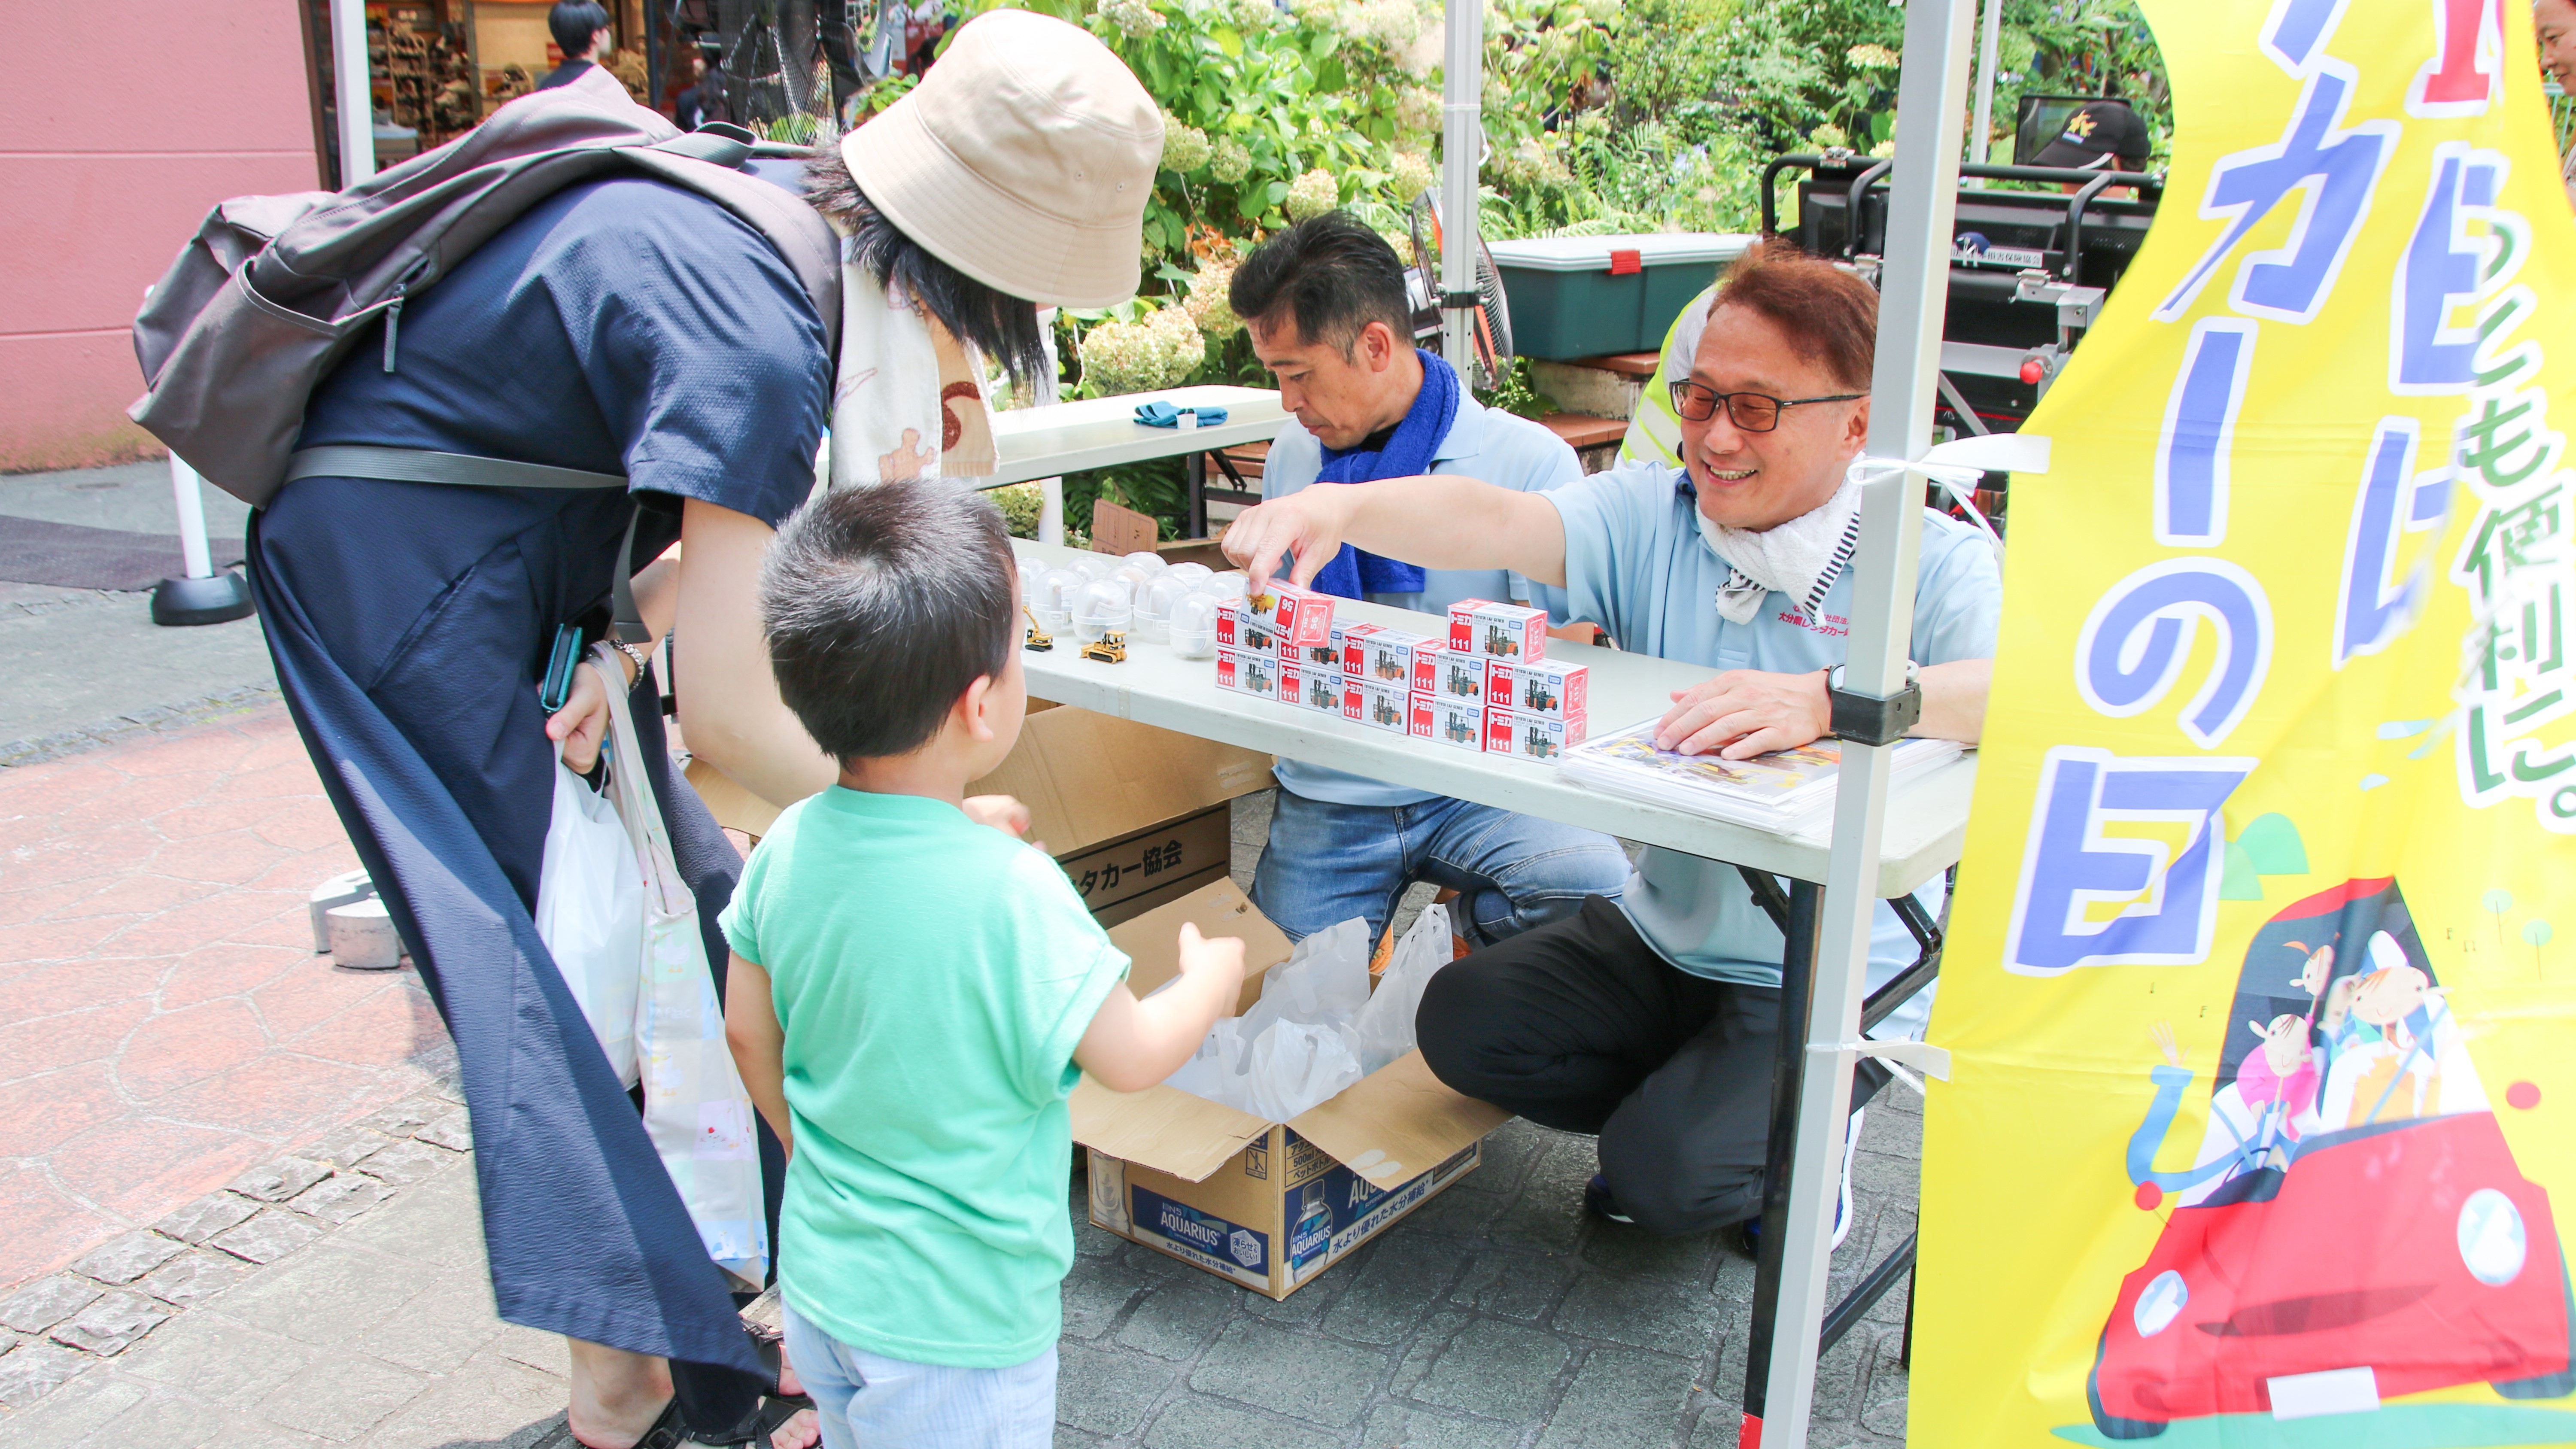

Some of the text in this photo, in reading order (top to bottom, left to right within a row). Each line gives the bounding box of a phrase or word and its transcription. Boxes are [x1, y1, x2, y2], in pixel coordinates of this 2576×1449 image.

[2011, 0, 2387, 969] カーの日
[1282, 598, 1294, 612] 56
[1218, 609, 1234, 621] トミカ
[1451, 614, 1472, 626] トミカ
[1310, 617, 1318, 630] 56
[1218, 632, 1233, 643] 111
[1346, 638, 1364, 650] トミカ
[1451, 638, 1469, 650] 111
[1218, 652, 1235, 664] トミカ
[1282, 647, 1297, 658] 111
[1416, 653, 1436, 666] トミカ
[1345, 661, 1361, 673] 111
[1218, 674, 1233, 685] 111
[1282, 668, 1300, 679] トミカ
[1492, 667, 1512, 680] トミカ
[1345, 683, 1362, 695] トミカ
[1416, 677, 1433, 689] 111
[1282, 690, 1297, 701] 111
[1492, 691, 1510, 704] 111
[1345, 705, 1360, 718] 111
[1414, 700, 1433, 712] トミカ
[1492, 714, 1512, 727] トミカ
[1414, 723, 1431, 735] 111
[1492, 738, 1510, 751] 111
[1160, 1211, 1218, 1246] AQUARIUS
[1292, 1225, 1331, 1256] AQUARIUS
